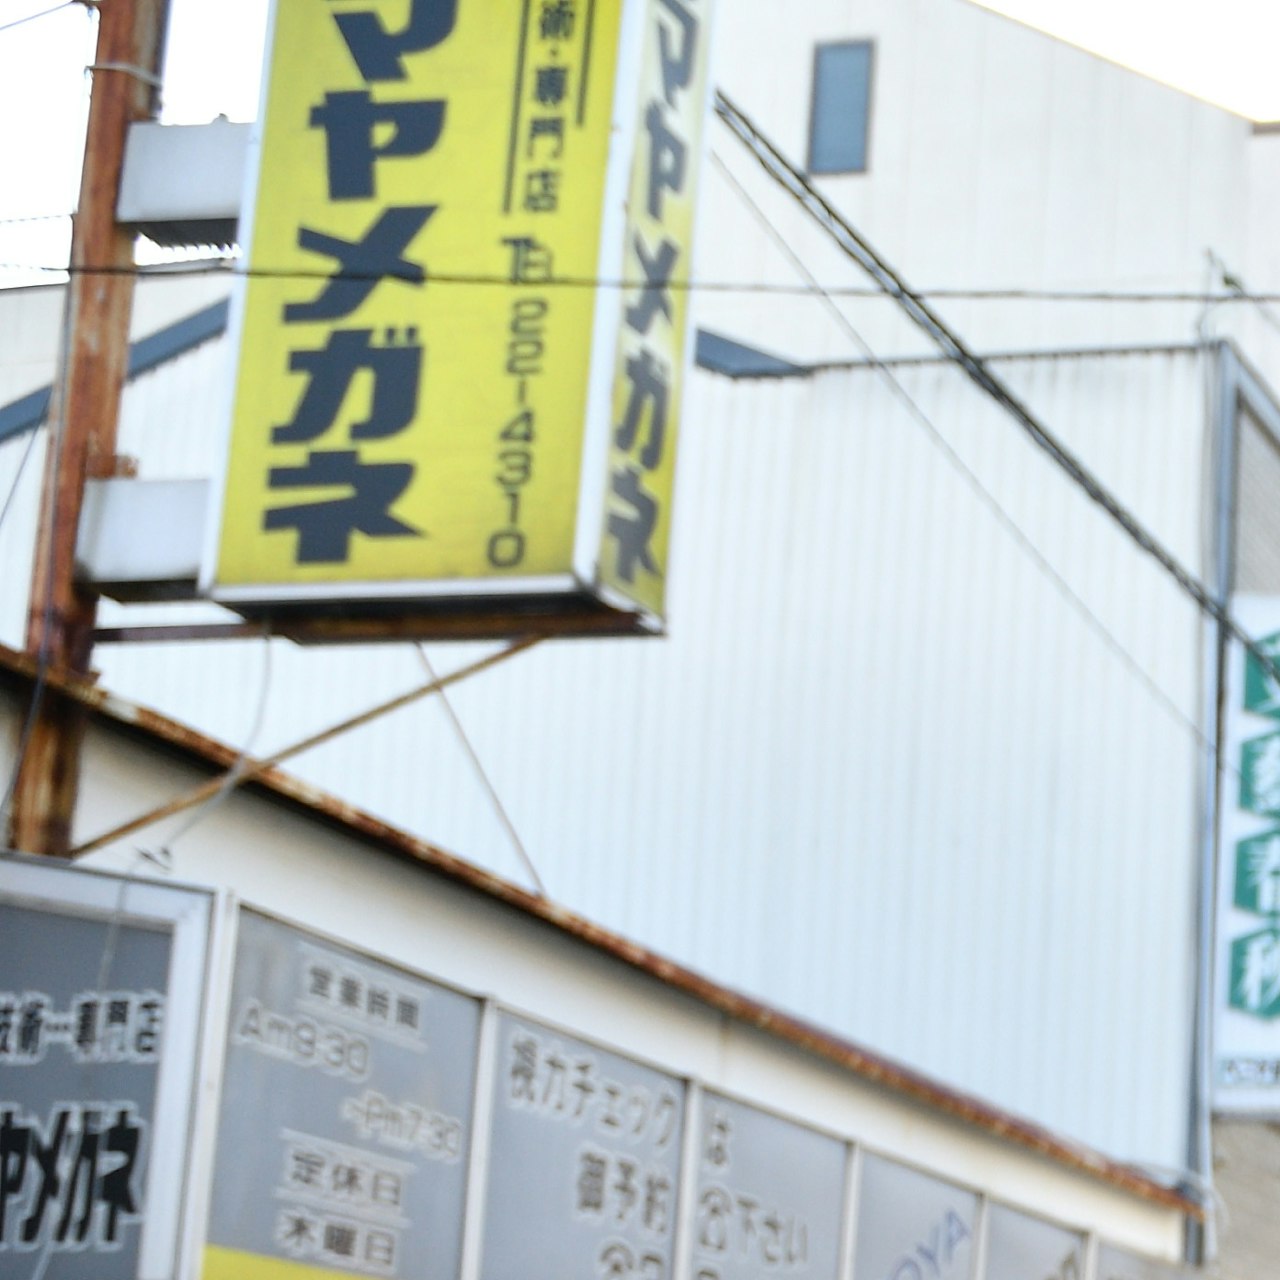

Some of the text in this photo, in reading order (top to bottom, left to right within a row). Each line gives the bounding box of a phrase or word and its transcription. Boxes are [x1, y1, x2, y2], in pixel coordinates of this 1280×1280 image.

[486, 300, 547, 570] 22-4310
[291, 1152, 400, 1206] 定休日
